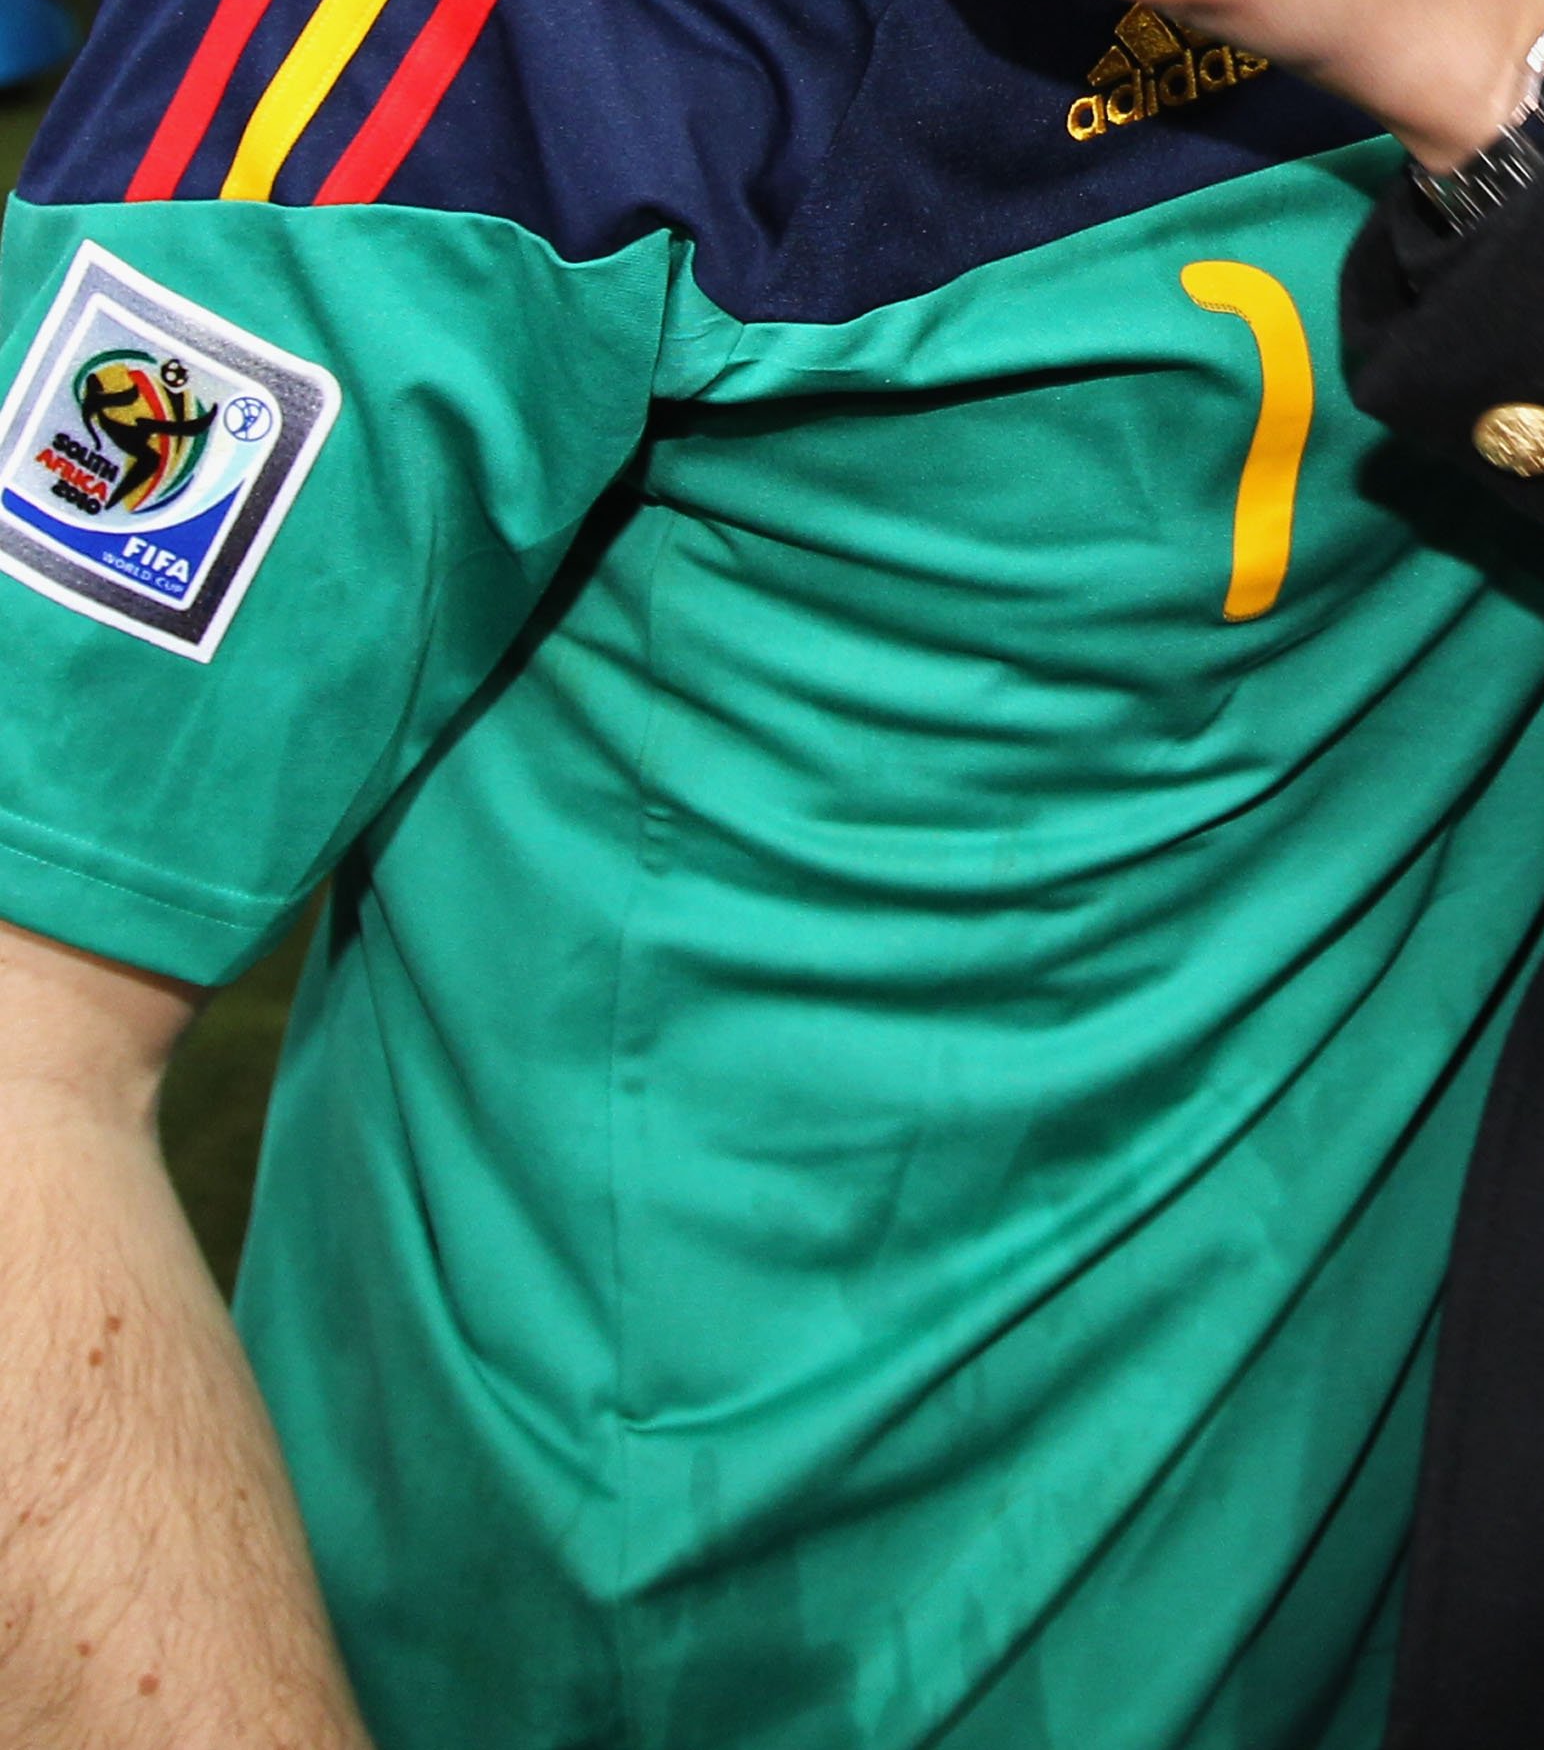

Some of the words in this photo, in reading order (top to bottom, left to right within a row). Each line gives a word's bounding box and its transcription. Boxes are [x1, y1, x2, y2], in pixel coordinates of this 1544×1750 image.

[1066, 45, 1269, 141] adidas
[52, 433, 119, 482] SOUTH
[51, 479, 101, 515] 2010
[102, 551, 153, 581] WORLD
[154, 576, 185, 594] CUP
[122, 536, 190, 583] FIFA
